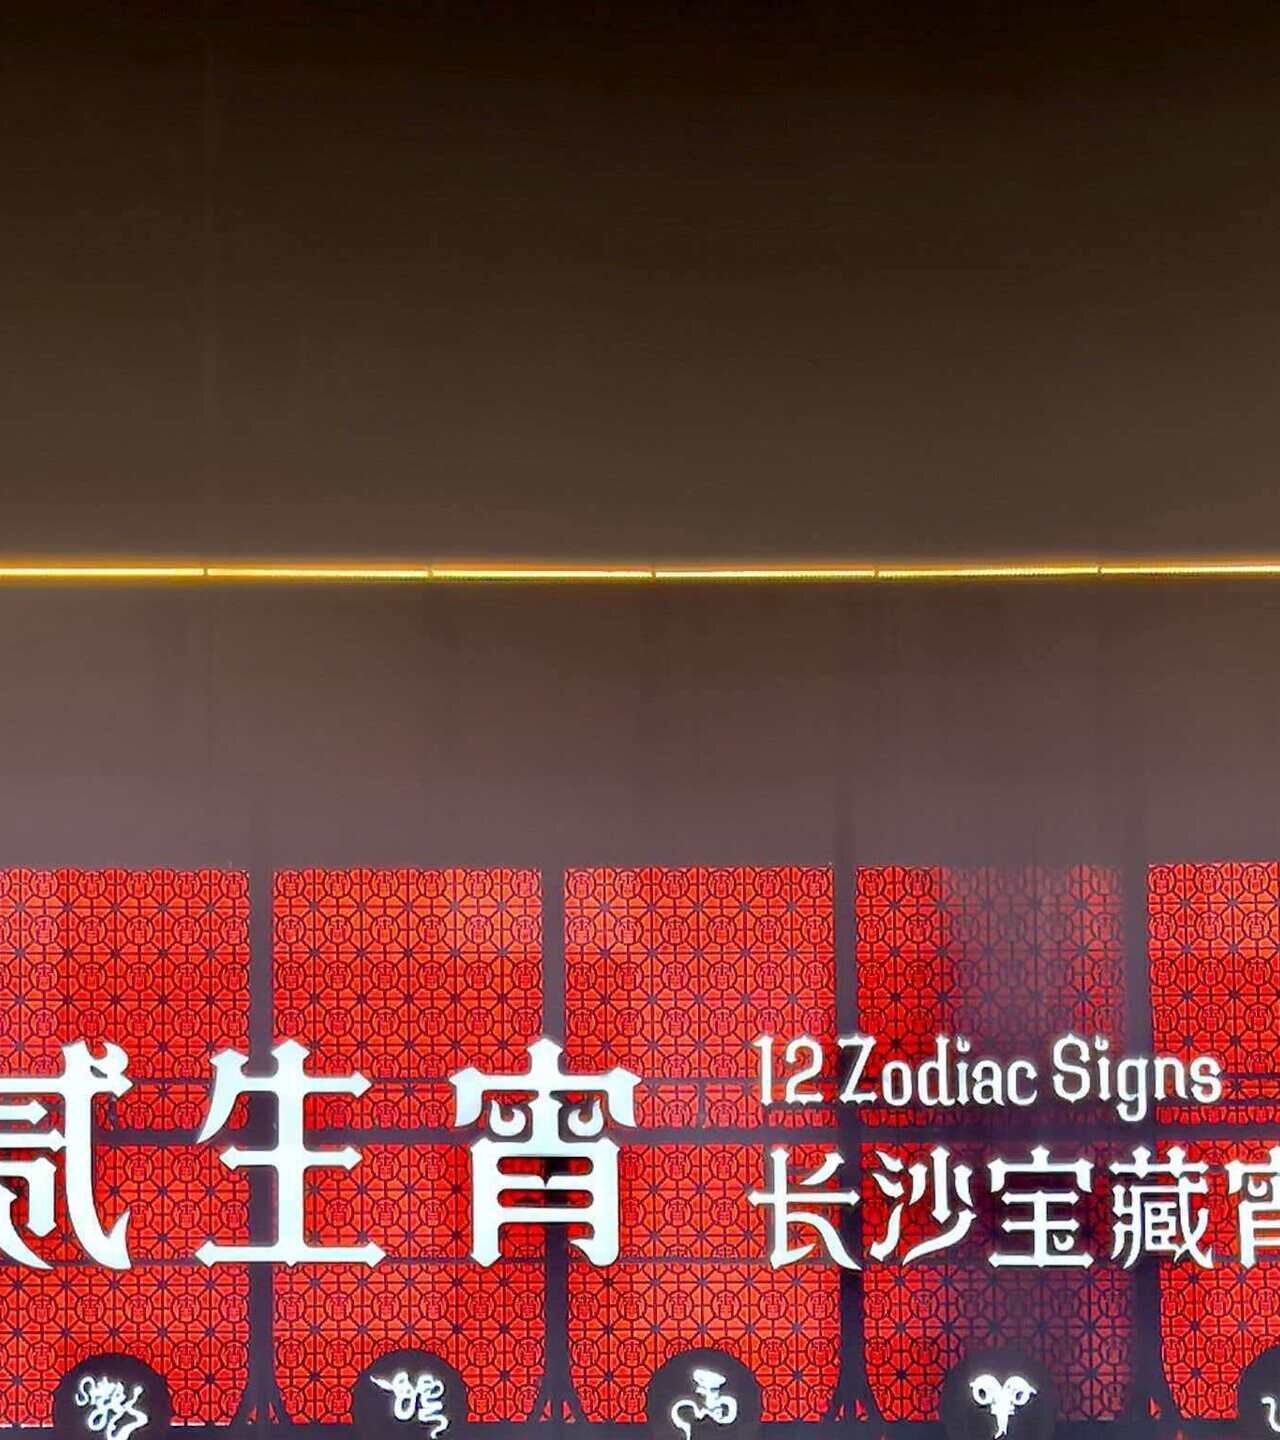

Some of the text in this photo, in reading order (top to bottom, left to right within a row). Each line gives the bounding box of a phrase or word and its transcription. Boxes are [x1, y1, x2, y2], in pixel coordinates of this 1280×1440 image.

[755, 1033, 1223, 1122] 12 Zodiac Signs
